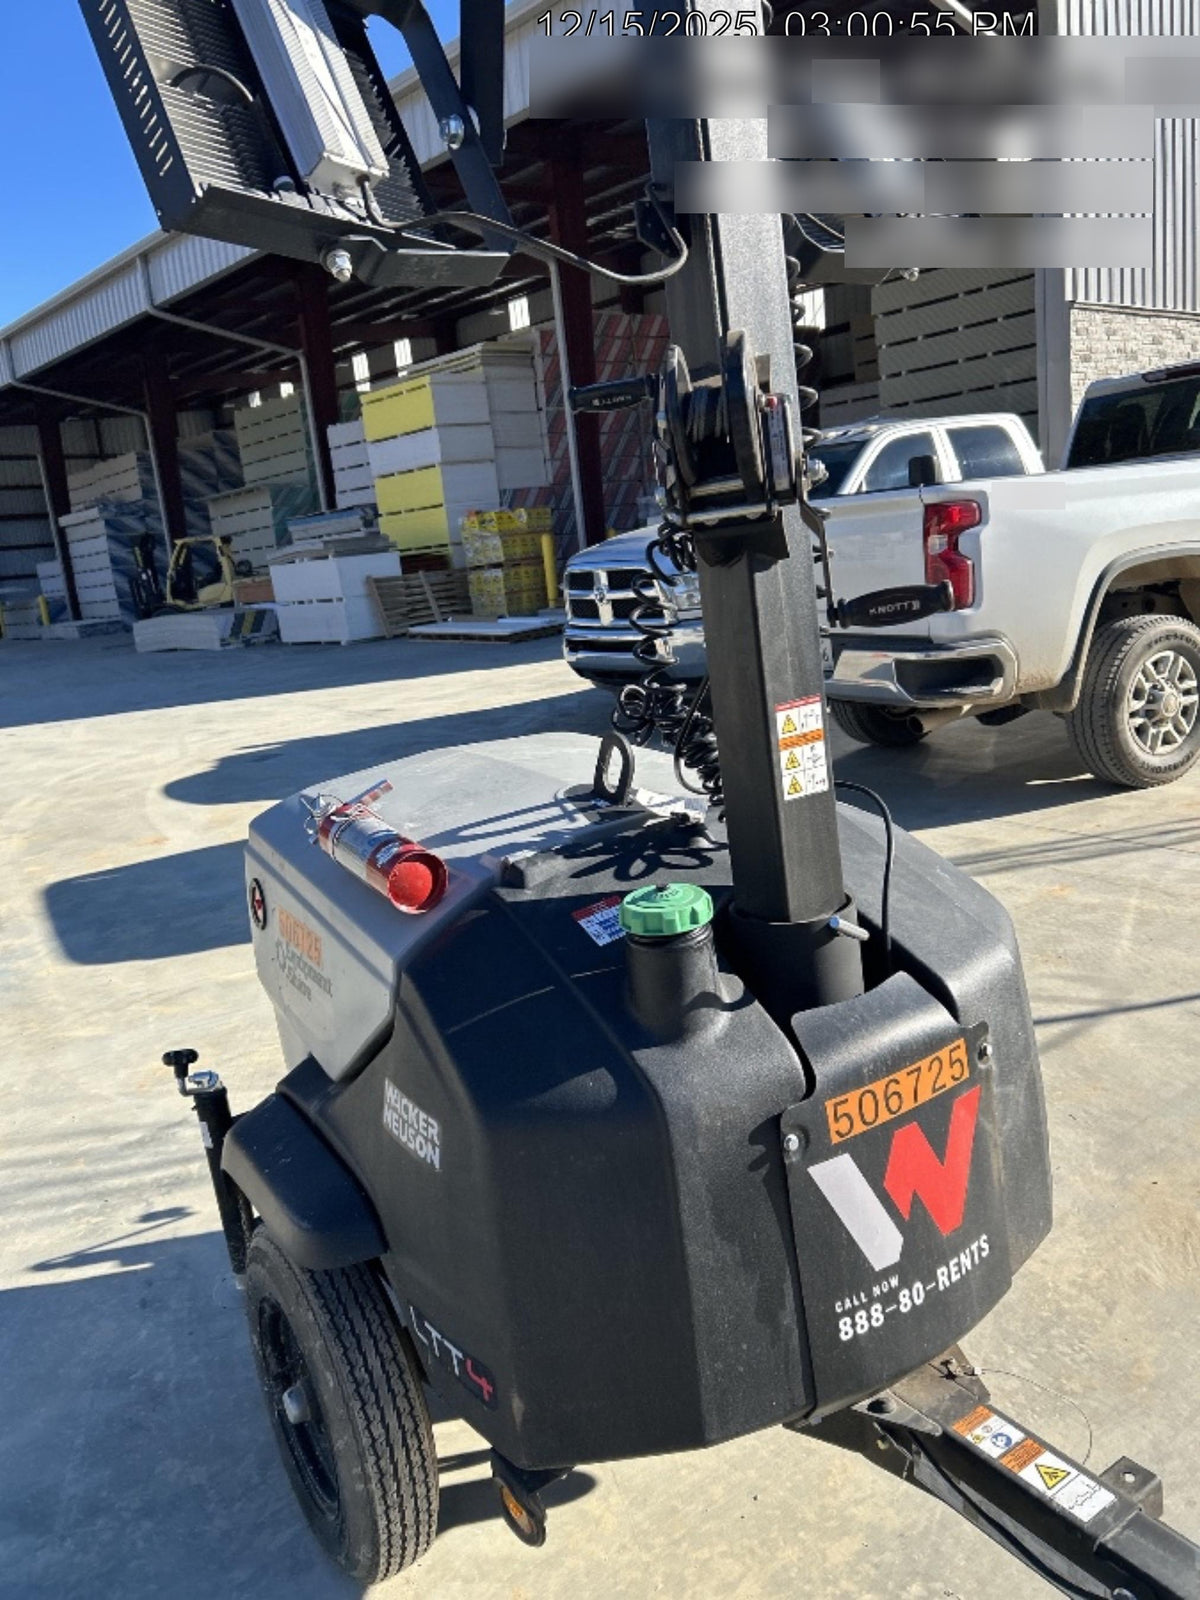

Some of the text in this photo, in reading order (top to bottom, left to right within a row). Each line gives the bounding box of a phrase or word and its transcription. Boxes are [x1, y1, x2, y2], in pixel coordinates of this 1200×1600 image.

[868, 600, 911, 616] KNOTT
[384, 1078, 440, 1146] WACKER
[832, 1044, 967, 1139] 506725
[383, 1103, 441, 1170] NEUSON
[834, 1274, 900, 1313] CALL NOW
[838, 1233, 990, 1342] 888-80-RENTS
[409, 1305, 494, 1403] LTT4
